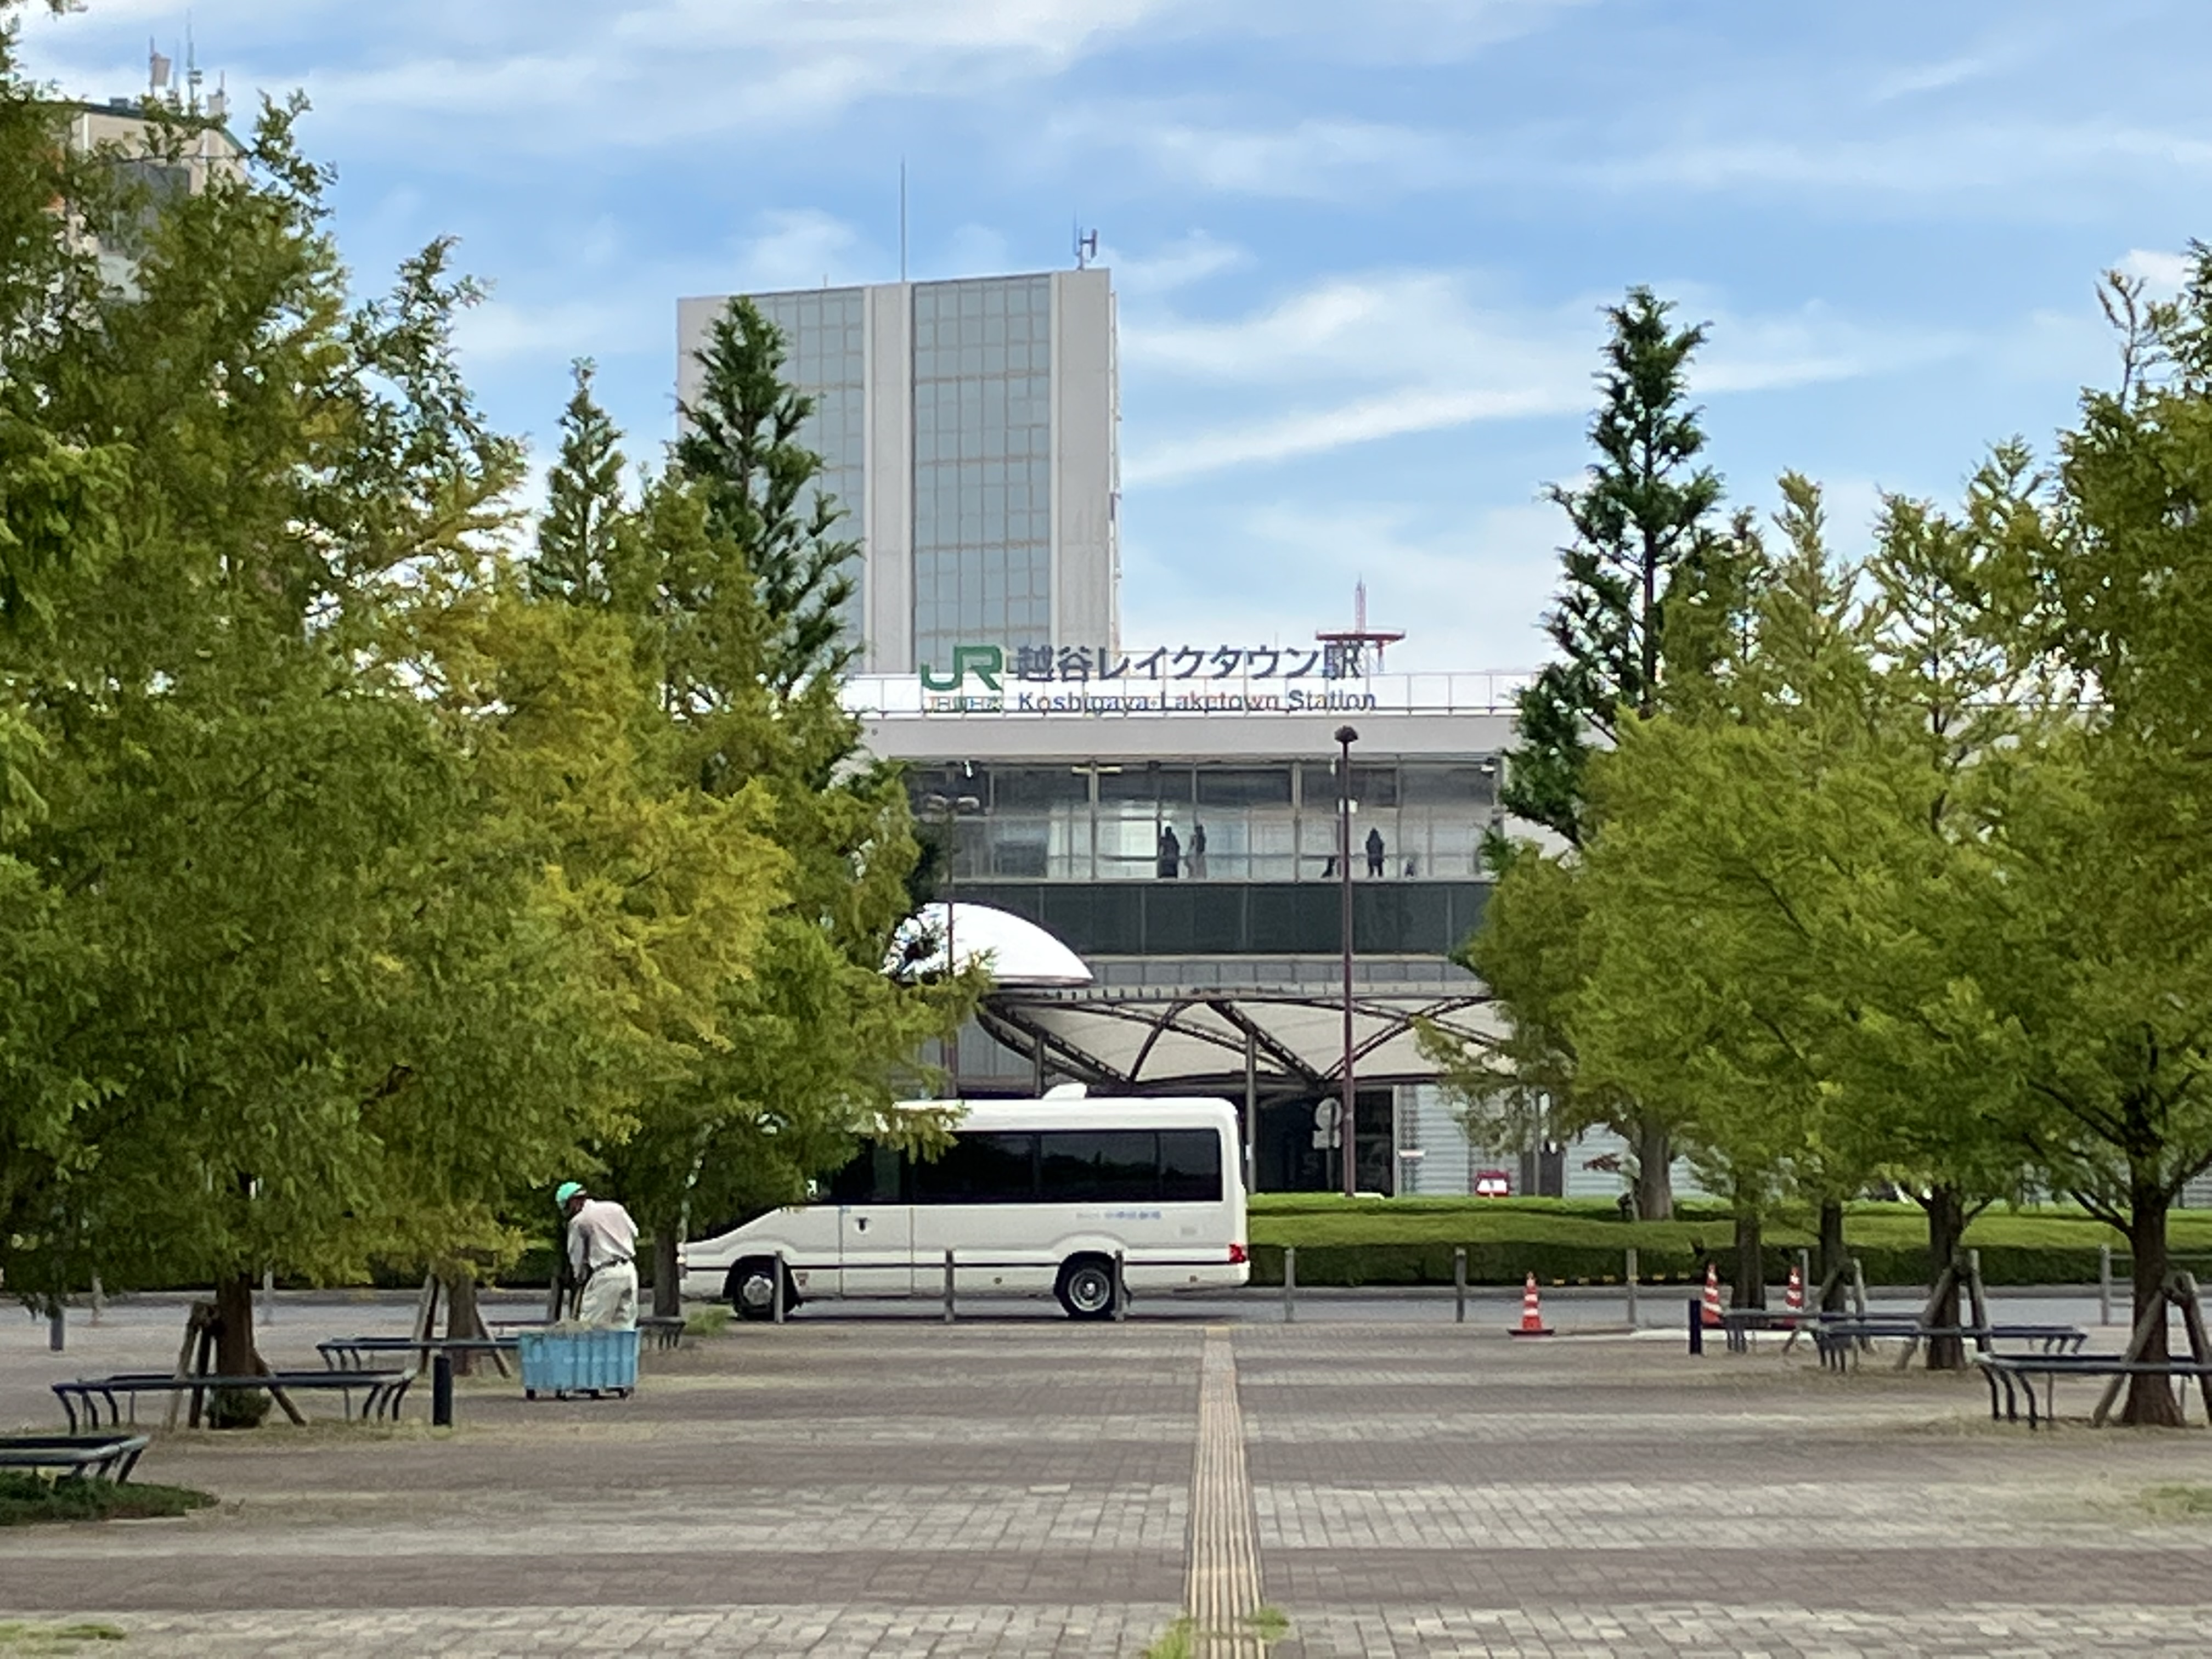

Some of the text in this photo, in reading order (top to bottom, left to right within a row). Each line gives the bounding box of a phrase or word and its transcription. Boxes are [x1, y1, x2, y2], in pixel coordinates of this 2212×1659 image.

[921, 645, 1002, 691] JR
[1018, 644, 1363, 681] 越谷レイクタウン駅
[1288, 690, 1376, 711] Station
